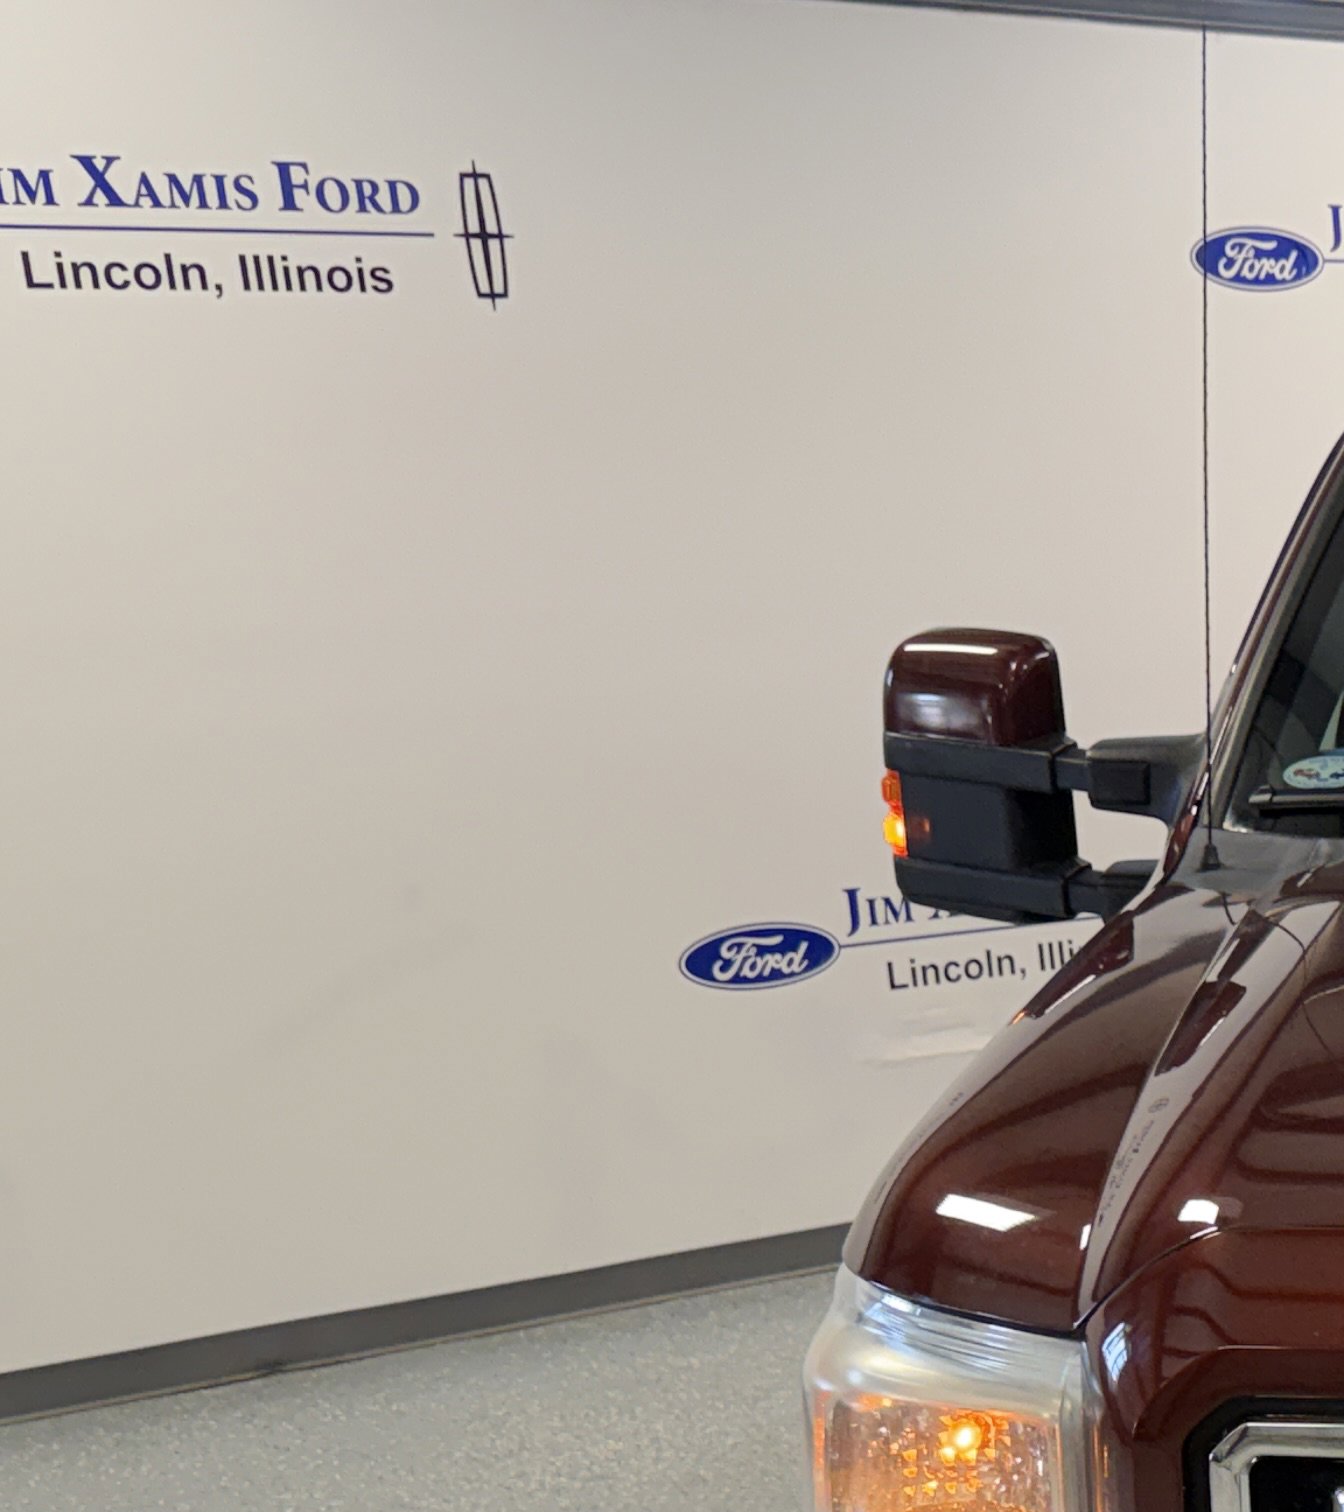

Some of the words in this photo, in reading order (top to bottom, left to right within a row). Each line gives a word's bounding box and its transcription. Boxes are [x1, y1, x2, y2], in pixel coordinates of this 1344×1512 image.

[69, 154, 259, 212] XAMIS
[271, 160, 420, 215] FORD
[20, 250, 224, 299] Lincoln,
[238, 254, 394, 294] Illinois
[1218, 234, 1298, 281] Ford
[843, 887, 914, 937] JIM
[712, 934, 808, 981] Ford
[887, 949, 1026, 990] Lincoln,
[1038, 939, 1074, 971] Illi
